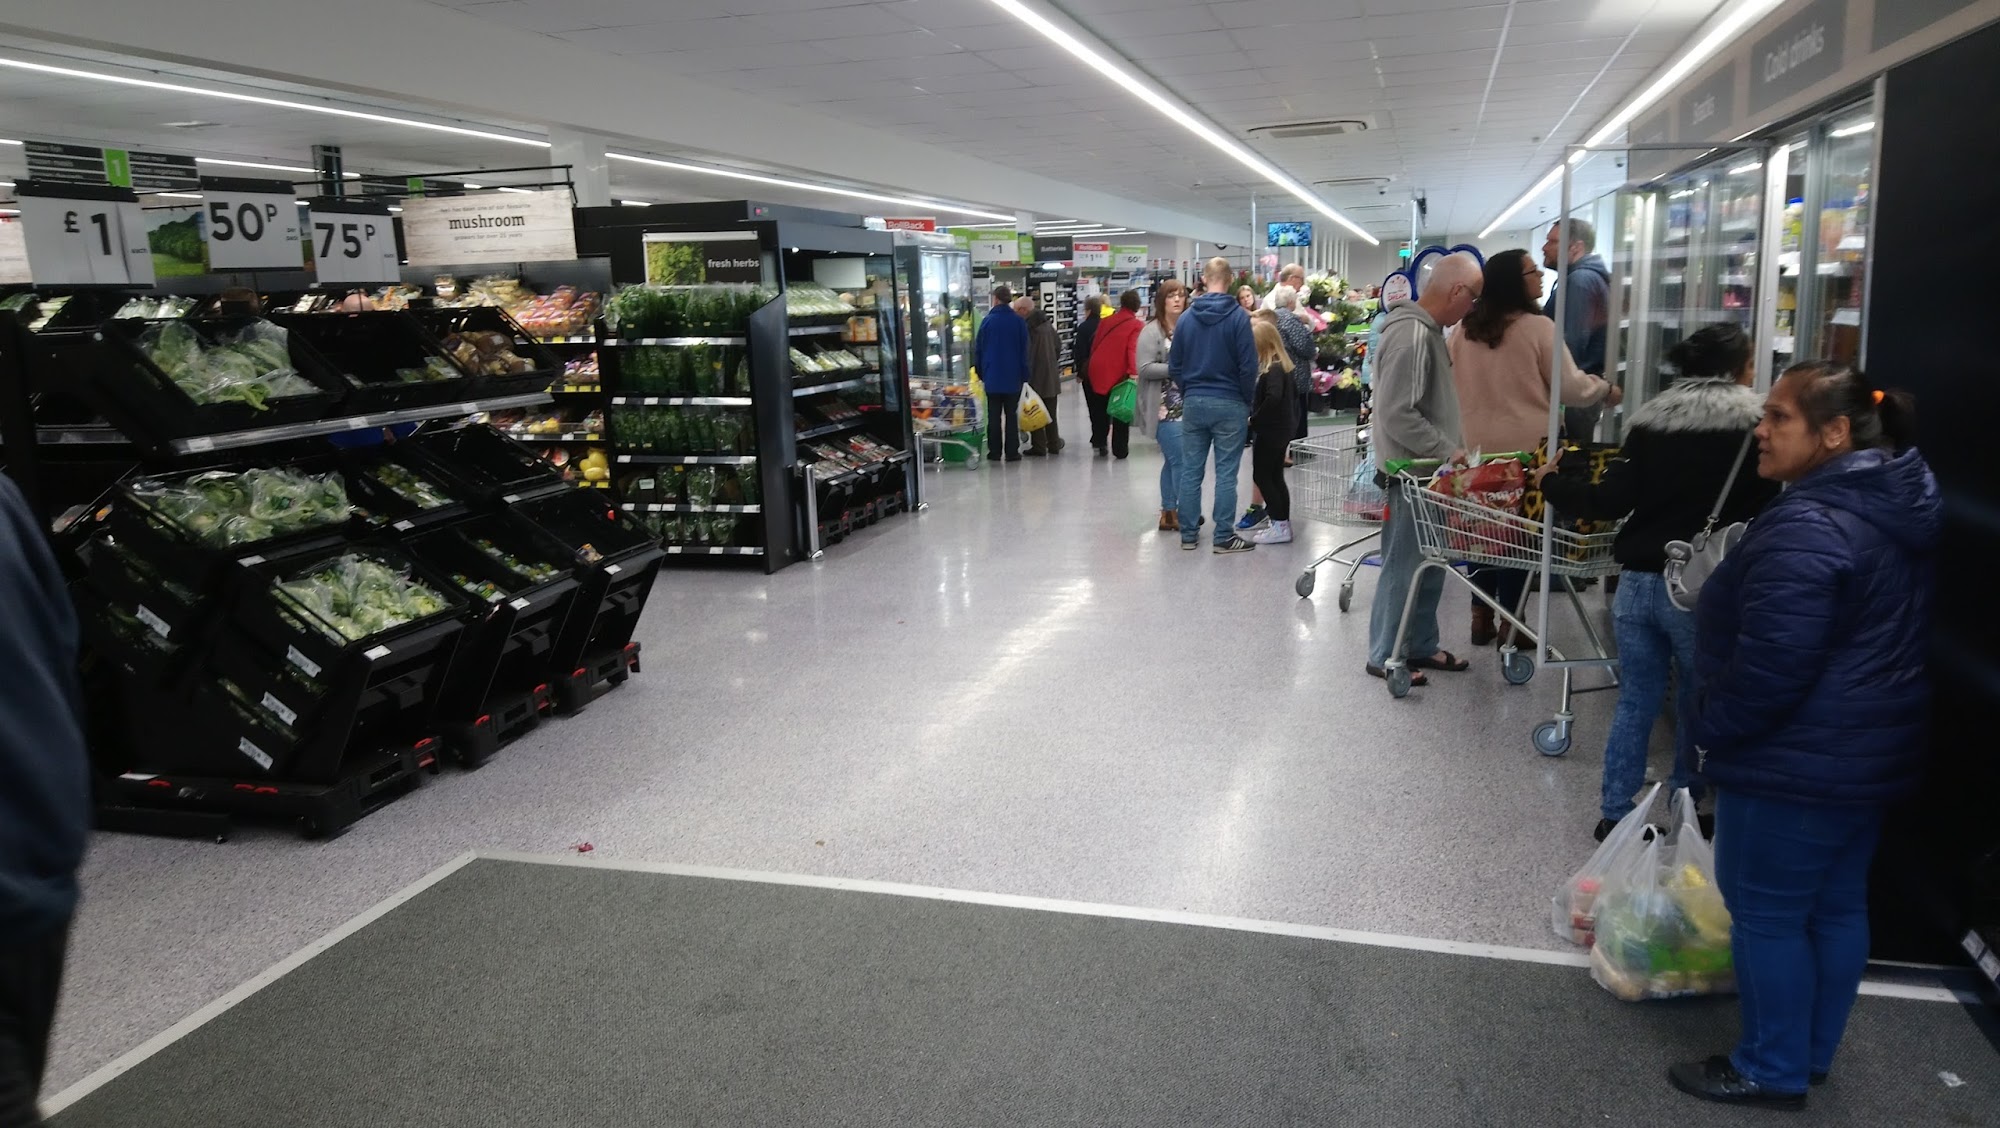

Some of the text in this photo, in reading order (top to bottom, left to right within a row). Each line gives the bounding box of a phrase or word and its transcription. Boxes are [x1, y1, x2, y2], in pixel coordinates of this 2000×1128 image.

[112, 159, 122, 177] 1
[448, 214, 525, 230] mushroom
[887, 220, 925, 230] RollBack
[707, 258, 760, 268] fresh herbs
